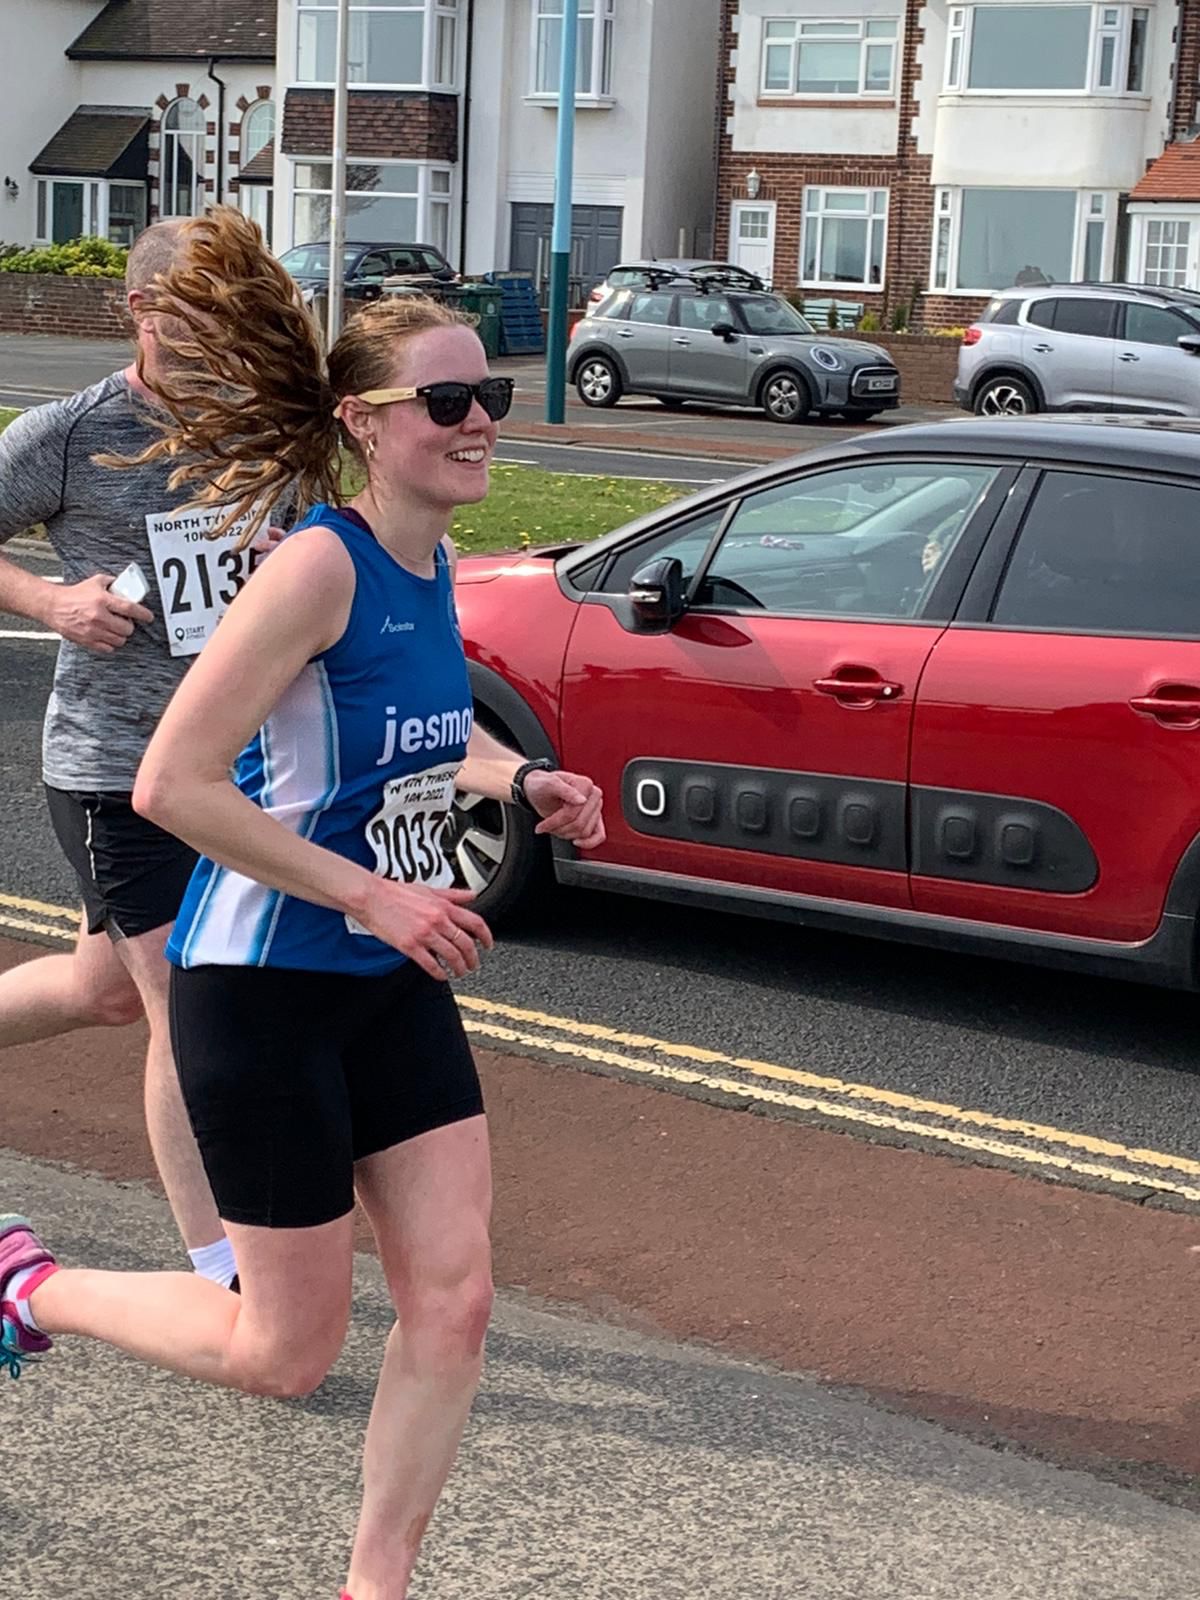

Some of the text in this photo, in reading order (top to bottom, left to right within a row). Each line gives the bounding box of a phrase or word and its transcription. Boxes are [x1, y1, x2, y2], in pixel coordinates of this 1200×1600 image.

[154, 517, 200, 533] NORTH
[376, 706, 474, 766] jesmo
[371, 810, 448, 884] 2037
